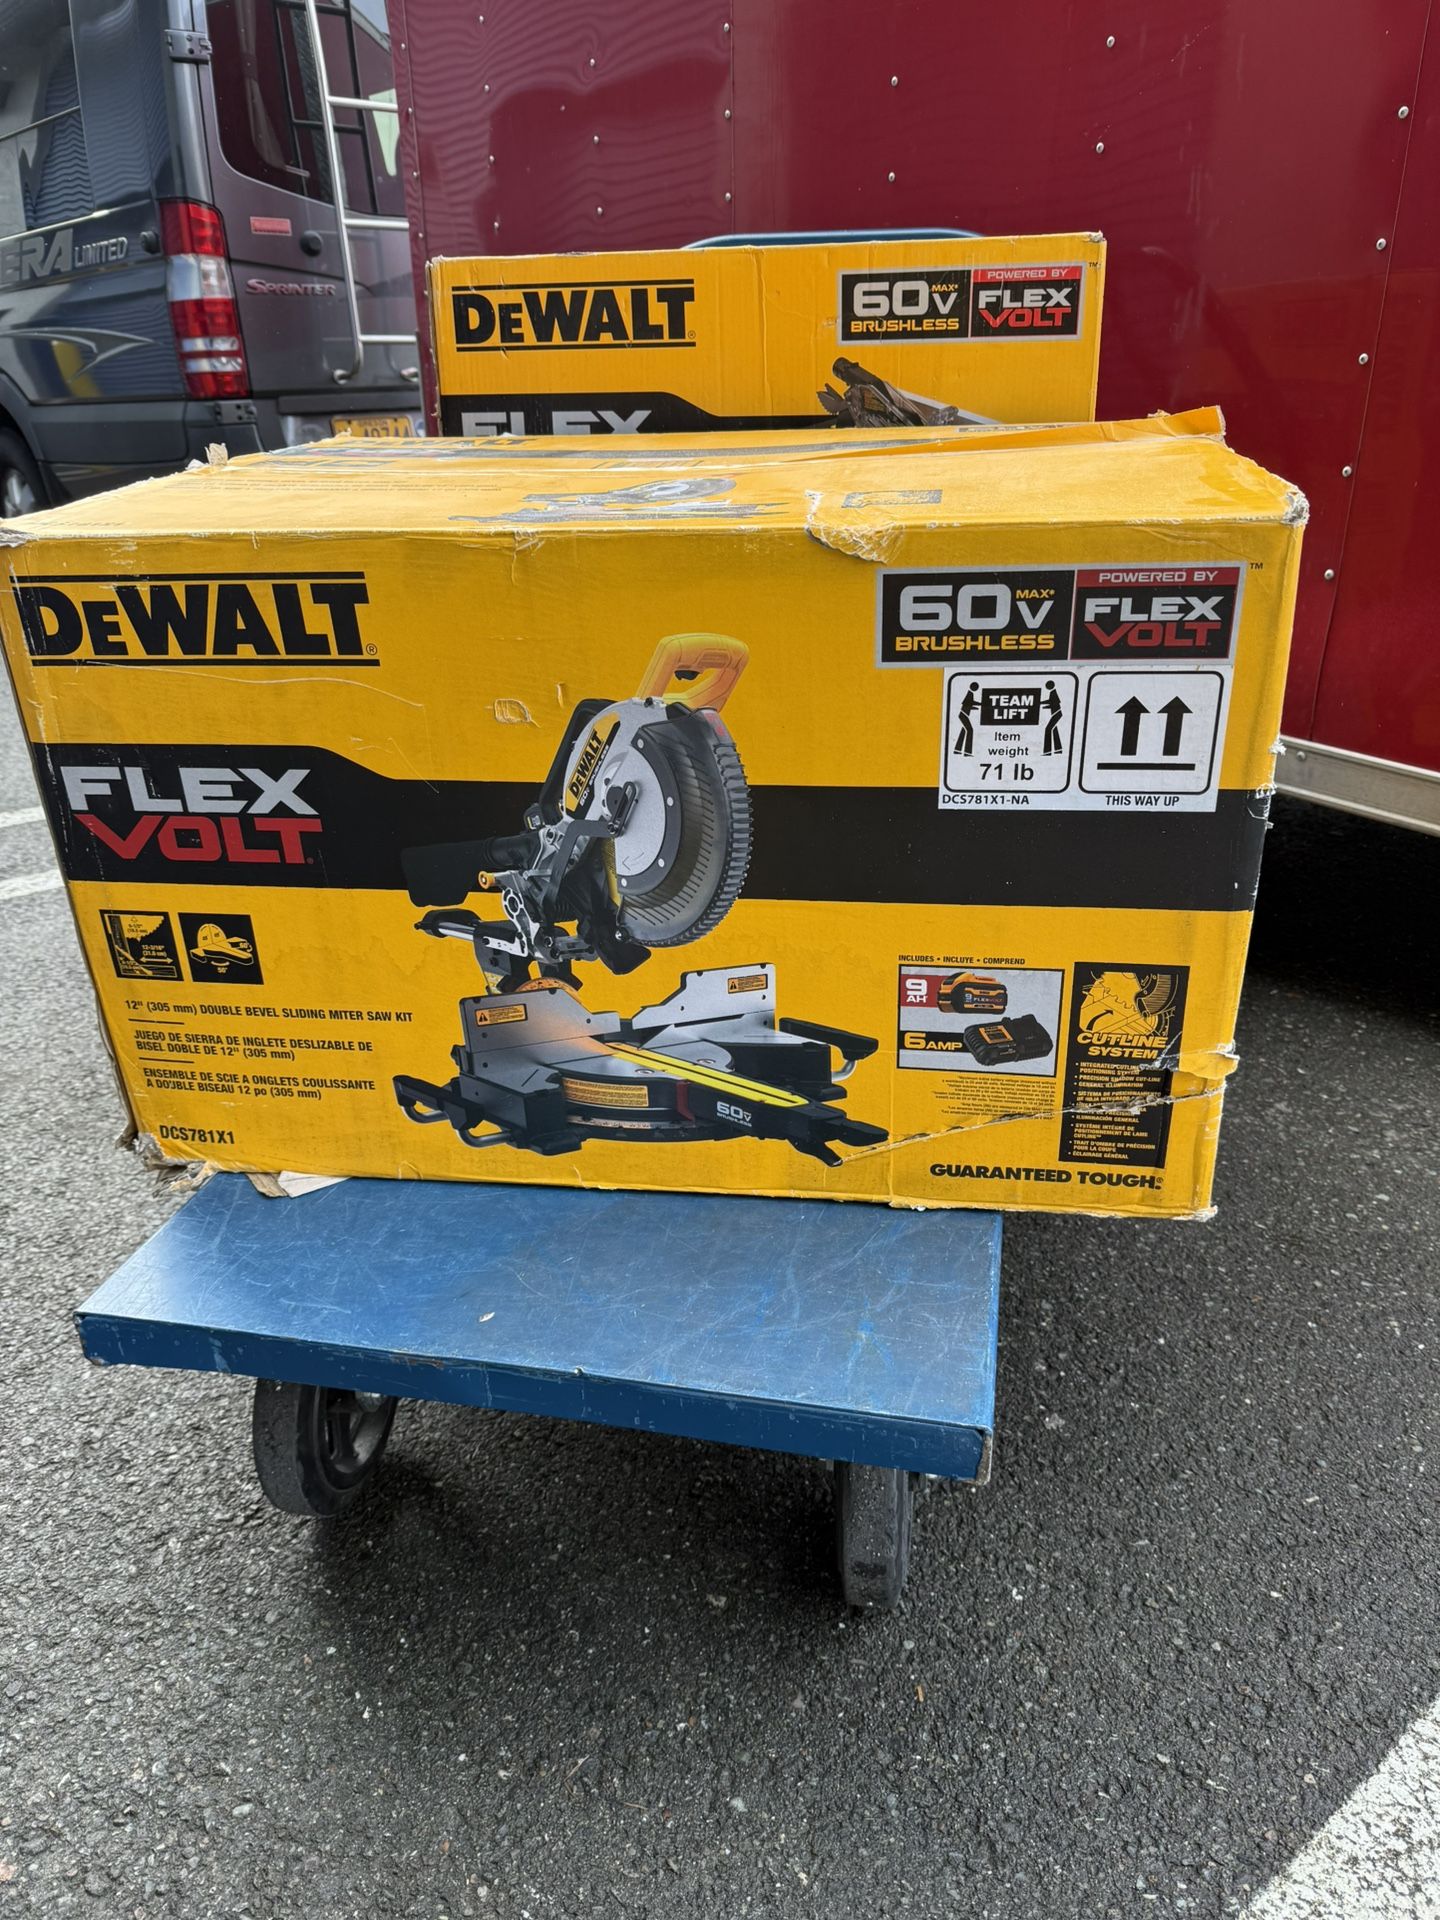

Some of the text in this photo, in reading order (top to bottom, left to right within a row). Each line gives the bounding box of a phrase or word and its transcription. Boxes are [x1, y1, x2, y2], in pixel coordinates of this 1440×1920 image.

[75, 236, 128, 268] LIMITED
[988, 269, 1068, 280] POWERED BY
[979, 288, 1072, 308] FLEX
[452, 287, 695, 345] DEWALT
[979, 308, 1071, 328] VOLT
[851, 318, 959, 333] BRUSHLESS
[1099, 570, 1218, 583] POWERED BY
[1085, 596, 1224, 622] FLEX
[12, 582, 370, 657] DEWALT
[895, 634, 1055, 652] BRUSHLESS
[1084, 622, 1221, 648] VOLT
[989, 695, 1034, 706] TEAM
[993, 709, 1028, 719] LIFT
[994, 731, 1021, 741] Item
[988, 746, 1029, 758] weight
[980, 763, 1034, 780] 71 lb
[60, 766, 319, 815] FLEX
[942, 794, 1030, 805] DCS781X1-NA
[1105, 795, 1179, 806] THIS WAY UP
[74, 814, 323, 865] VOLT
[899, 955, 1025, 965] INCLUDES INCLUYE COMPREND
[906, 978, 928, 995] 9
[126, 1000, 412, 1021] 12" (305 mm) DOUBLE BEVEL SLIDING MITER SAW KIT
[134, 1030, 373, 1051] JUEGO DE SIERRA DE INGLETE DESLIZABLE DE
[1077, 1032, 1168, 1049] CUTLINE
[136, 1040, 295, 1061] BISEL DOBLE DE 12" (305 mm)
[1088, 1046, 1159, 1059] SYSTEM
[143, 1068, 197, 1080] ENSEMBLE
[199, 1071, 214, 1082] DE
[216, 1073, 239, 1083] SCIE
[252, 1075, 299, 1087] ONGLETS
[302, 1077, 375, 1090] COULISSANTE
[198, 1082, 235, 1093] BISEAU
[238, 1085, 251, 1095] 12
[254, 1087, 267, 1097] po
[270, 1087, 294, 1098] (305
[297, 1089, 322, 1100] mm)
[160, 1124, 235, 1144] DCS781X1
[930, 1163, 1072, 1183] GUARANTEED
